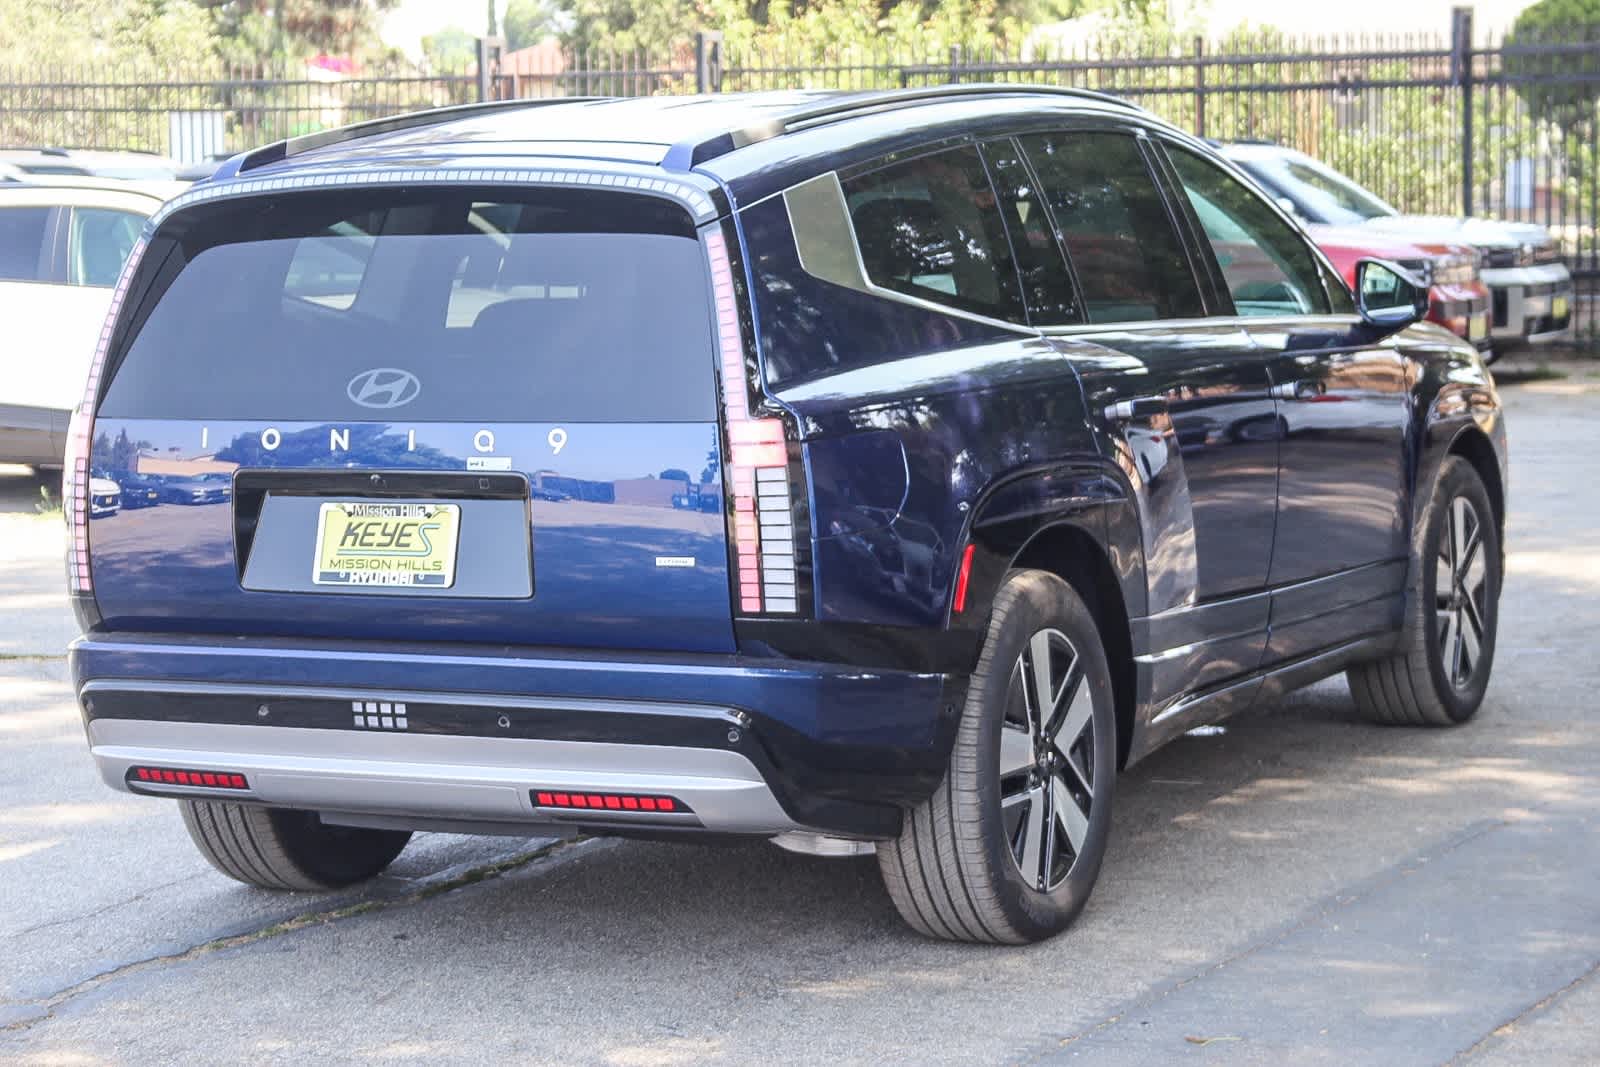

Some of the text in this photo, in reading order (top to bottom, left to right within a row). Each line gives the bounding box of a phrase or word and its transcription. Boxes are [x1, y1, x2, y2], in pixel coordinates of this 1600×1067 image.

[548, 428, 568, 454] 9
[352, 505, 426, 518] Mission Hills
[339, 521, 441, 557] KEYES
[329, 558, 443, 571] MISSION HILLS
